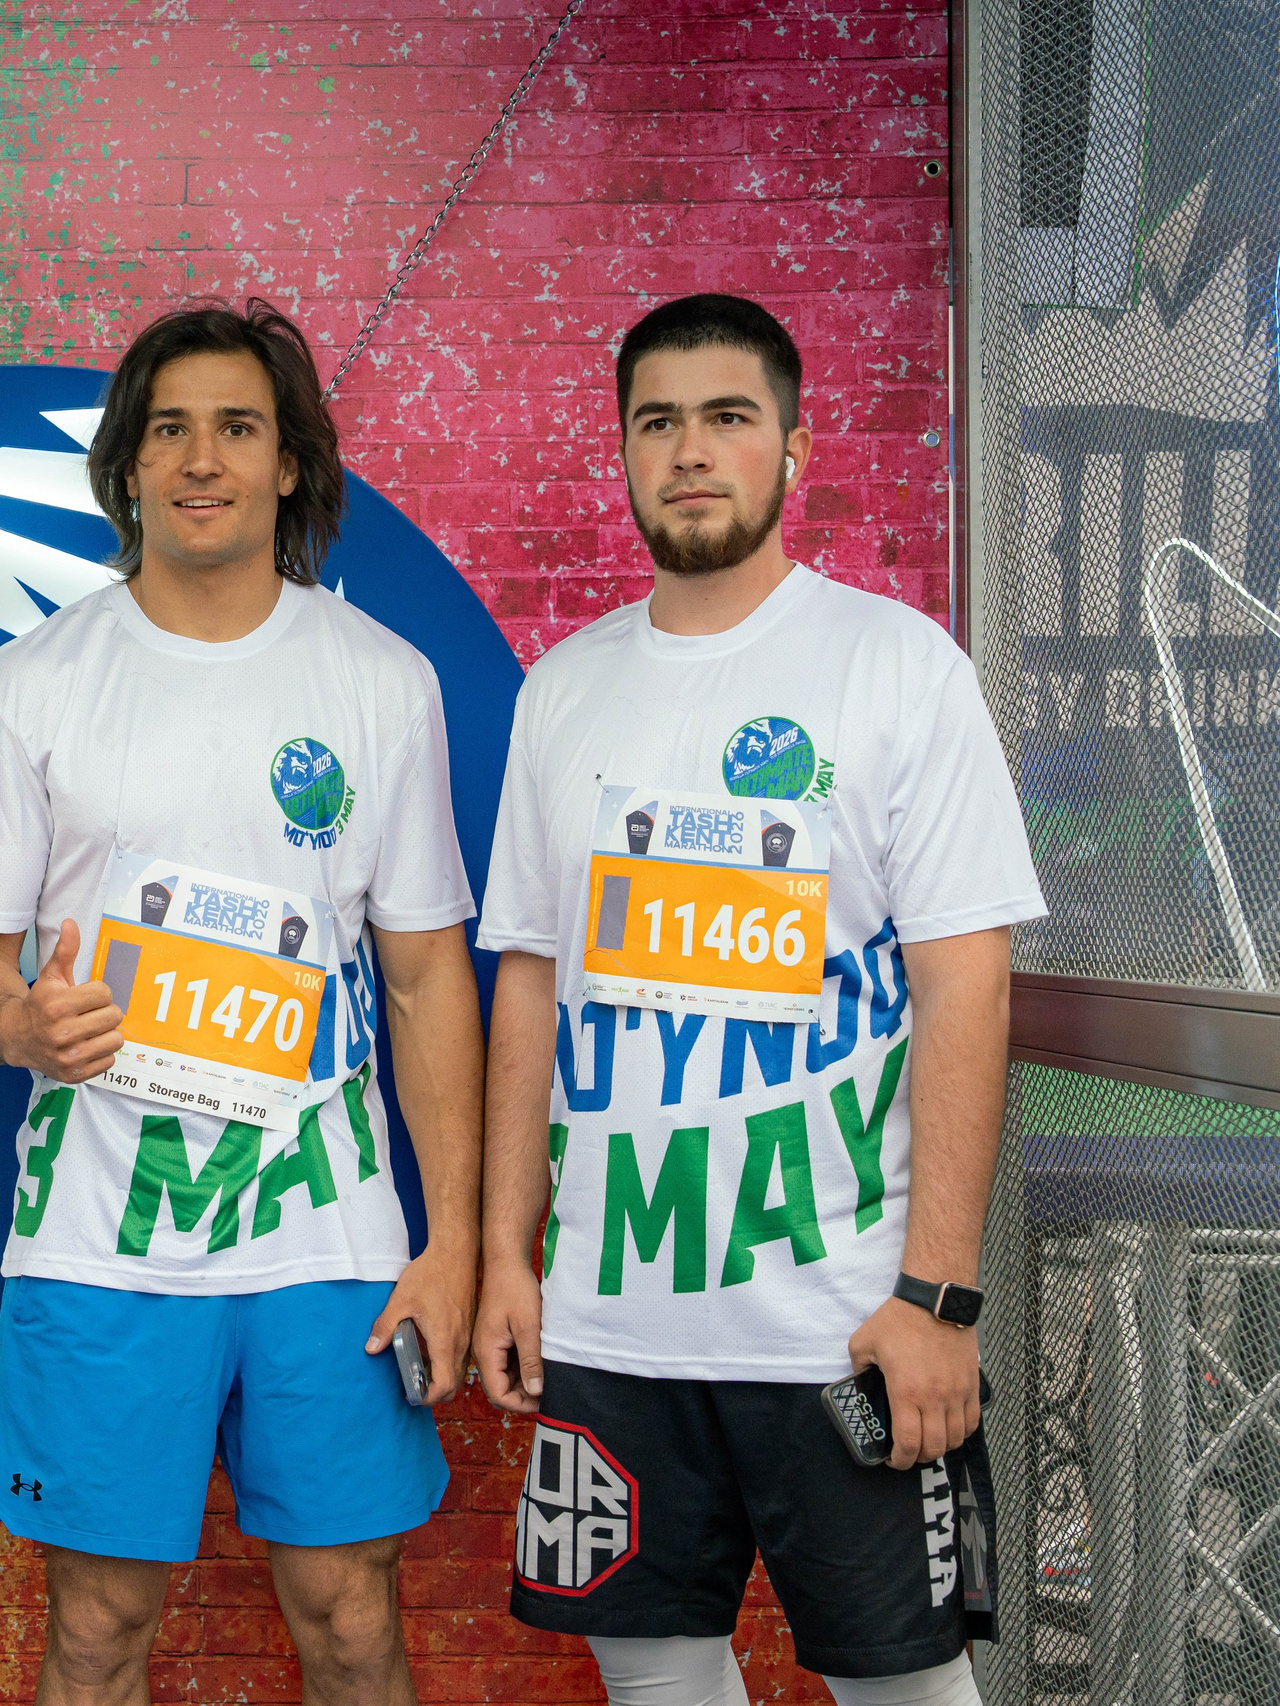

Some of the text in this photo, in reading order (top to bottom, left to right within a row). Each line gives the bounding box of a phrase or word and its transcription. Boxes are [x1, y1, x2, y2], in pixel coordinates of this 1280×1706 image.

[769, 726, 799, 757] 2026
[811, 757, 835, 798] MAY
[340, 785, 356, 823] MAY
[669, 805, 731, 816] INTERNATIONAL
[665, 824, 731, 846] KENT
[669, 810, 734, 834] TASH
[664, 840, 733, 854] MARATHON
[190, 888, 259, 920] TASH
[191, 882, 257, 902] INTERNATIONAL
[786, 880, 823, 897] 10K
[185, 901, 252, 930] KENT
[644, 898, 806, 967] 11466
[293, 971, 322, 991] 10K
[153, 970, 304, 1052] 11470
[102, 1071, 267, 1120] 11470 Storage Bag 11470
[14, 1087, 76, 1238] 3
[597, 1034, 910, 1296] MAY
[854, 1392, 886, 1441] 08:53
[524, 1422, 628, 1516] OR
[516, 1496, 628, 1588] MA
